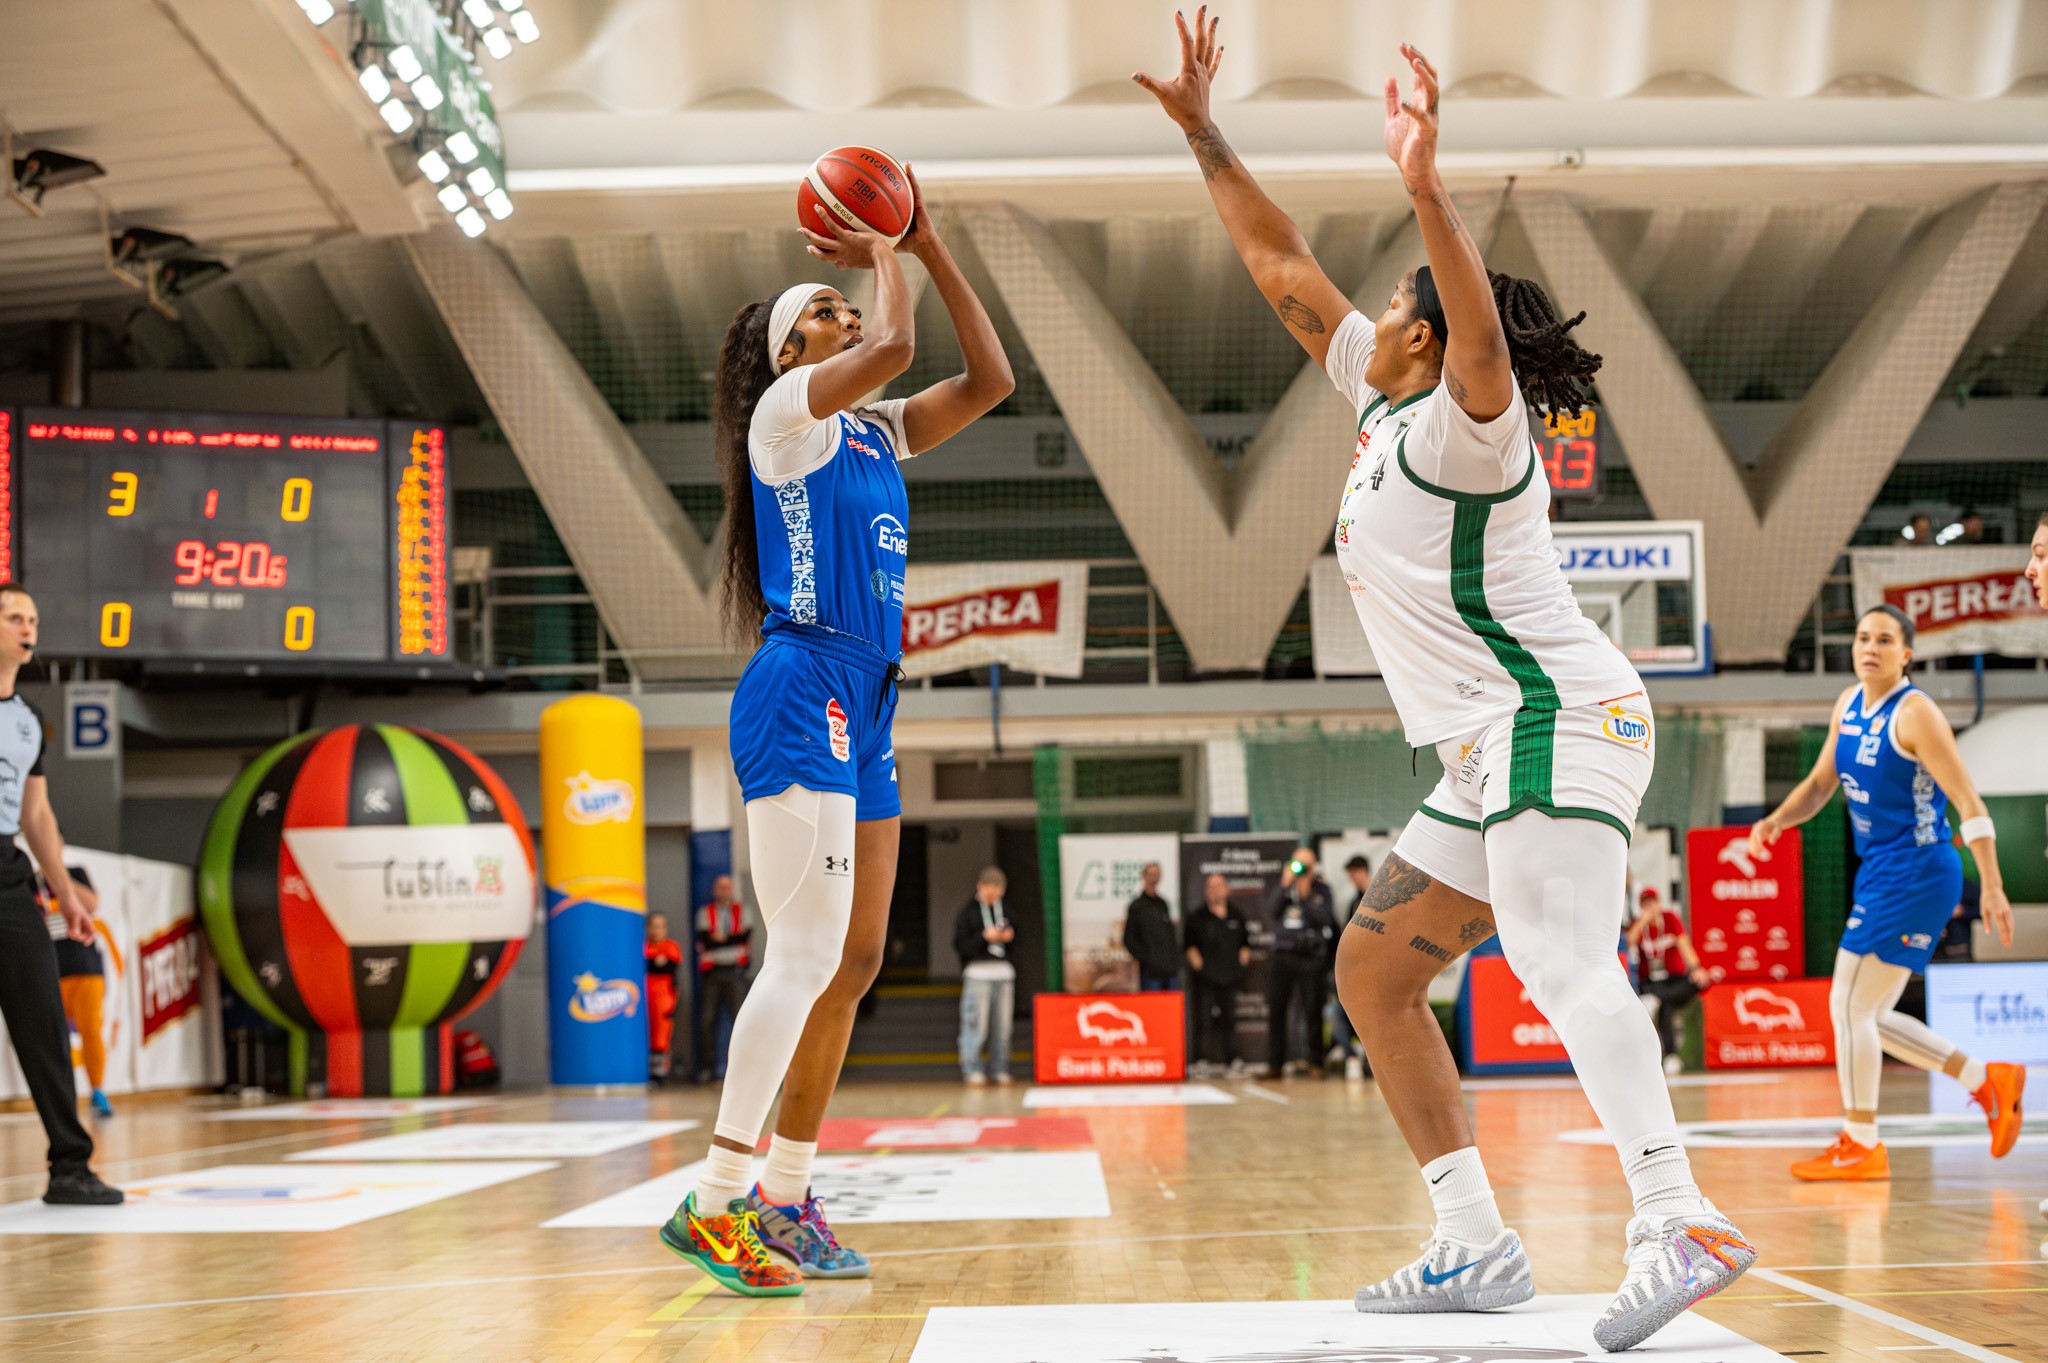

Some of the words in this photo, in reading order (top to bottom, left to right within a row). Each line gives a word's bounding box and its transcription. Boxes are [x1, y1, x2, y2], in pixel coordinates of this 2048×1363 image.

[860, 153, 902, 192] molten
[852, 178, 878, 203] FIBA
[107, 472, 138, 517] 3
[281, 477, 313, 522] 0
[1559, 547, 1671, 570] UZUKI
[1905, 575, 2036, 624] PERŁA
[100, 602, 132, 648] 0
[284, 606, 315, 651] 0
[907, 590, 1042, 646] PERŁA
[73, 704, 109, 748] B
[1614, 718, 1646, 738] LOTTO
[1855, 734, 1881, 767] 12
[1711, 879, 1779, 900] ORLEN
[1512, 1022, 1562, 1046] ORL
[1057, 1055, 1106, 1078] Bank
[1720, 1041, 1767, 1064] Bank
